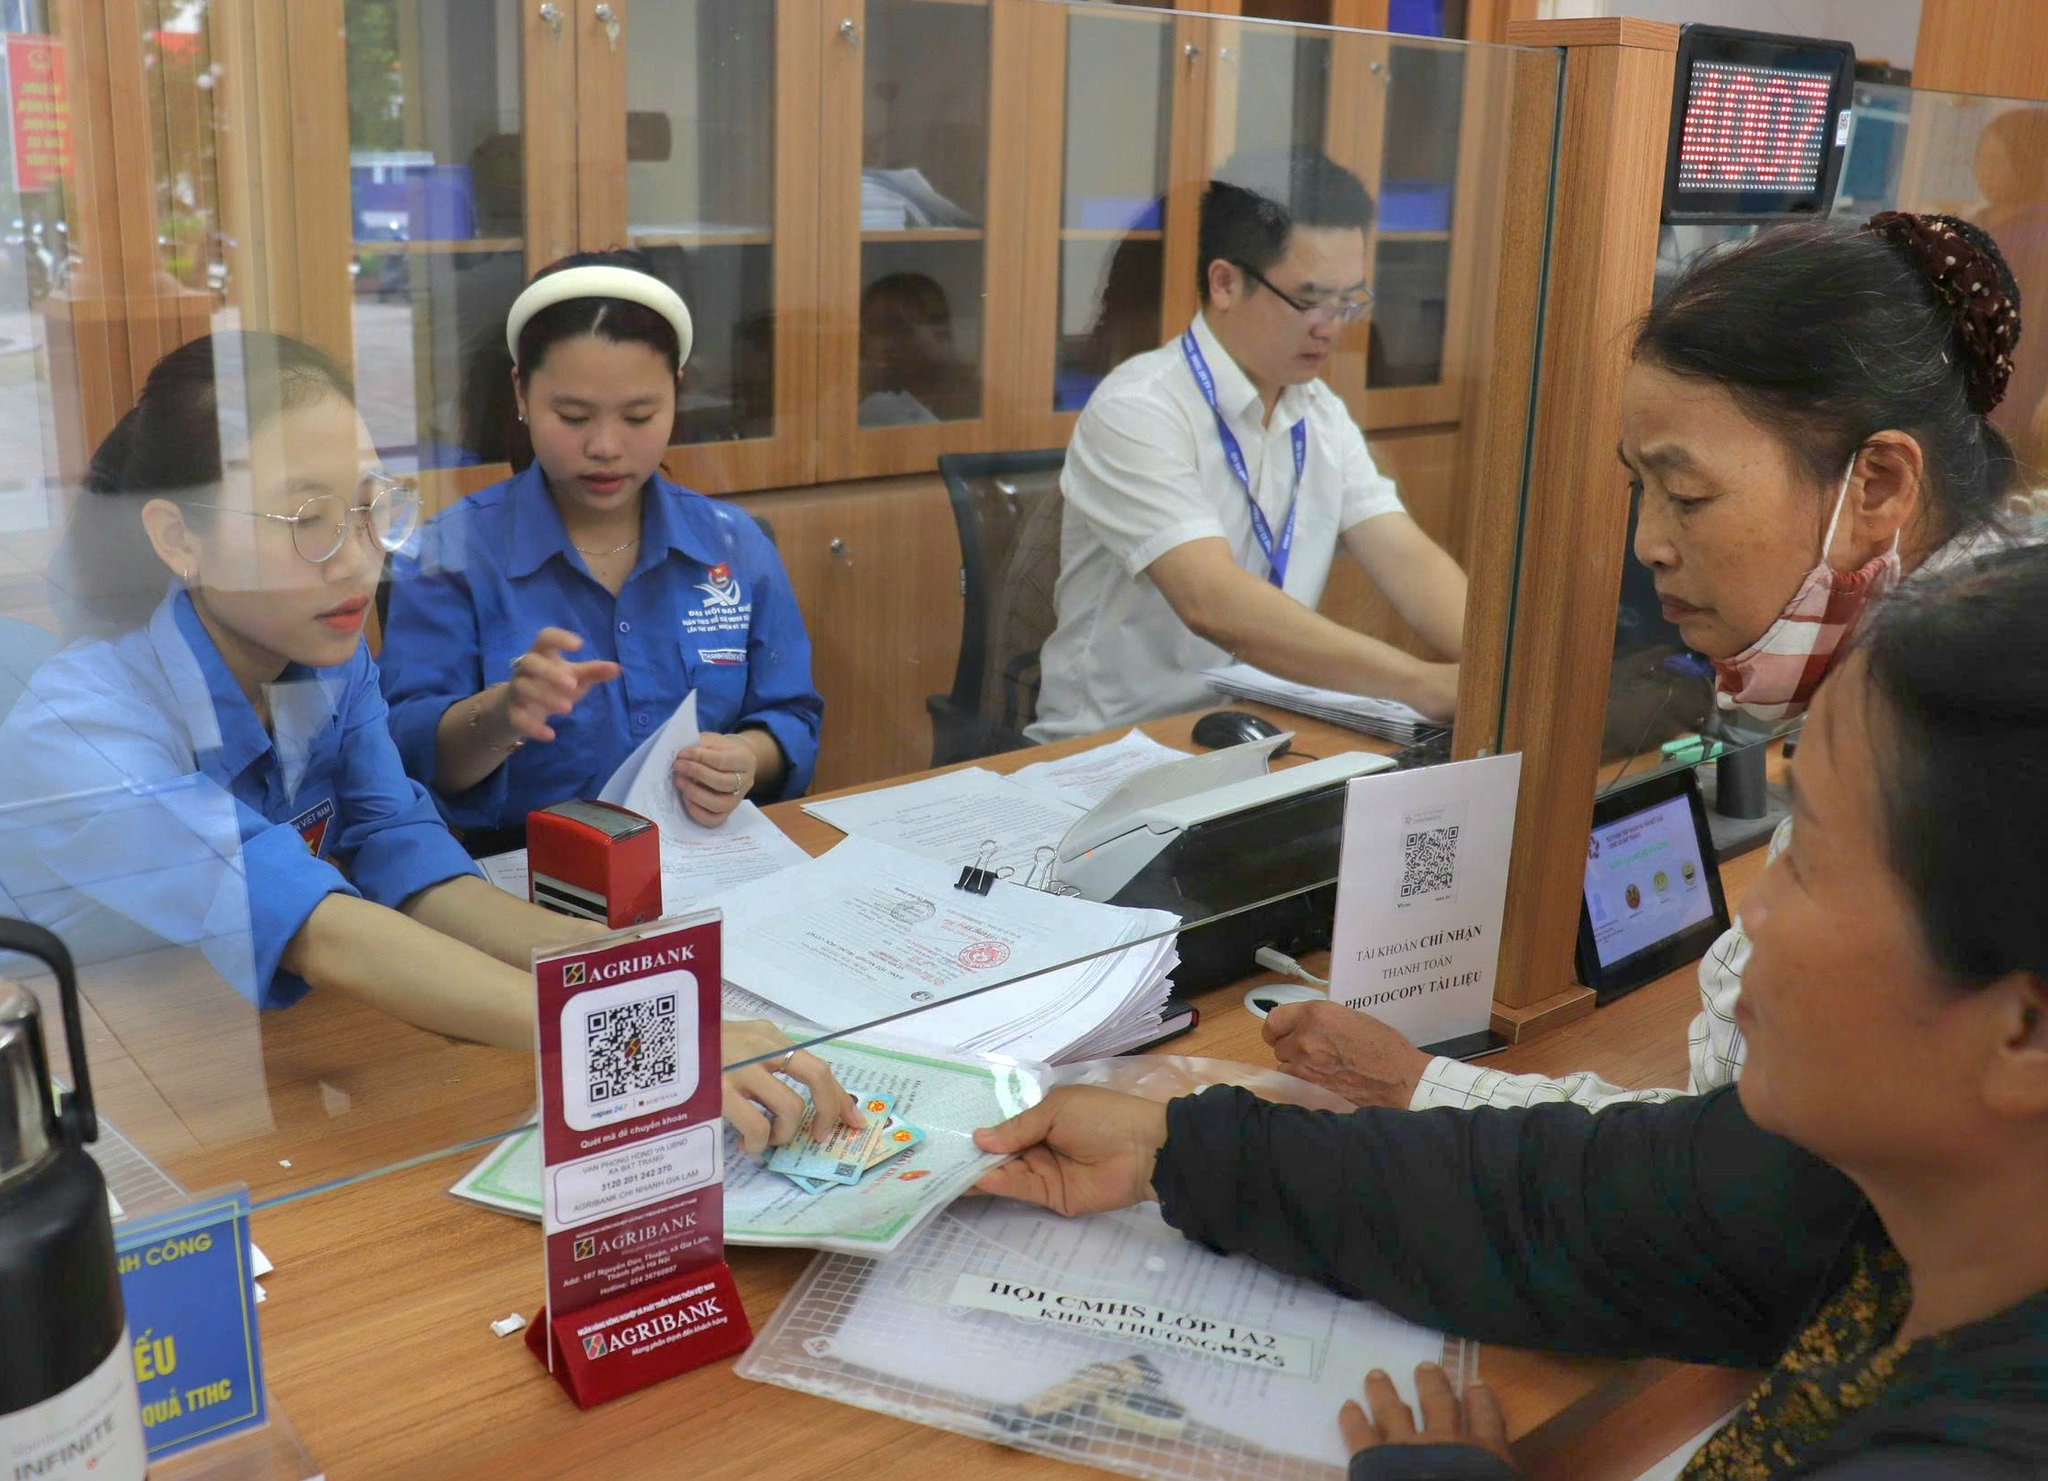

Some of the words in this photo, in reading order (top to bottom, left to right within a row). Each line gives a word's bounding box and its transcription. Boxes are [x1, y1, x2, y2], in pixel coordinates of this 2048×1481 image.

[1681, 73, 1829, 182] 4007
[1446, 925, 1483, 943] NHẬN
[588, 944, 696, 983] AGRIBANK
[1382, 963, 1420, 980] THANH
[1423, 954, 1454, 971] TOÁN
[1345, 983, 1426, 1010] PHOTOCOPY
[1428, 978, 1450, 993] TÀI
[1451, 970, 1483, 988] LIỆU
[580, 1137, 601, 1149] Quét
[601, 1179, 621, 1191] 3120
[624, 1174, 638, 1185] 201
[641, 1169, 655, 1180] 242
[657, 1164, 672, 1175] 370
[573, 1193, 617, 1212] AGRIBANK
[145, 1232, 213, 1267] CÔNG
[598, 1212, 697, 1255] AGRIBANK
[609, 1296, 723, 1353] AGRIBANK
[1040, 1308, 1107, 1327] KHEN
[1055, 1296, 1146, 1318] CMHS
[1157, 1311, 1217, 1333] LỚP
[1229, 1328, 1277, 1349] 1A2
[141, 1388, 182, 1428] QUẢ
[185, 1379, 233, 1413] TTHC
[13, 1414, 116, 1480] INFINITE
